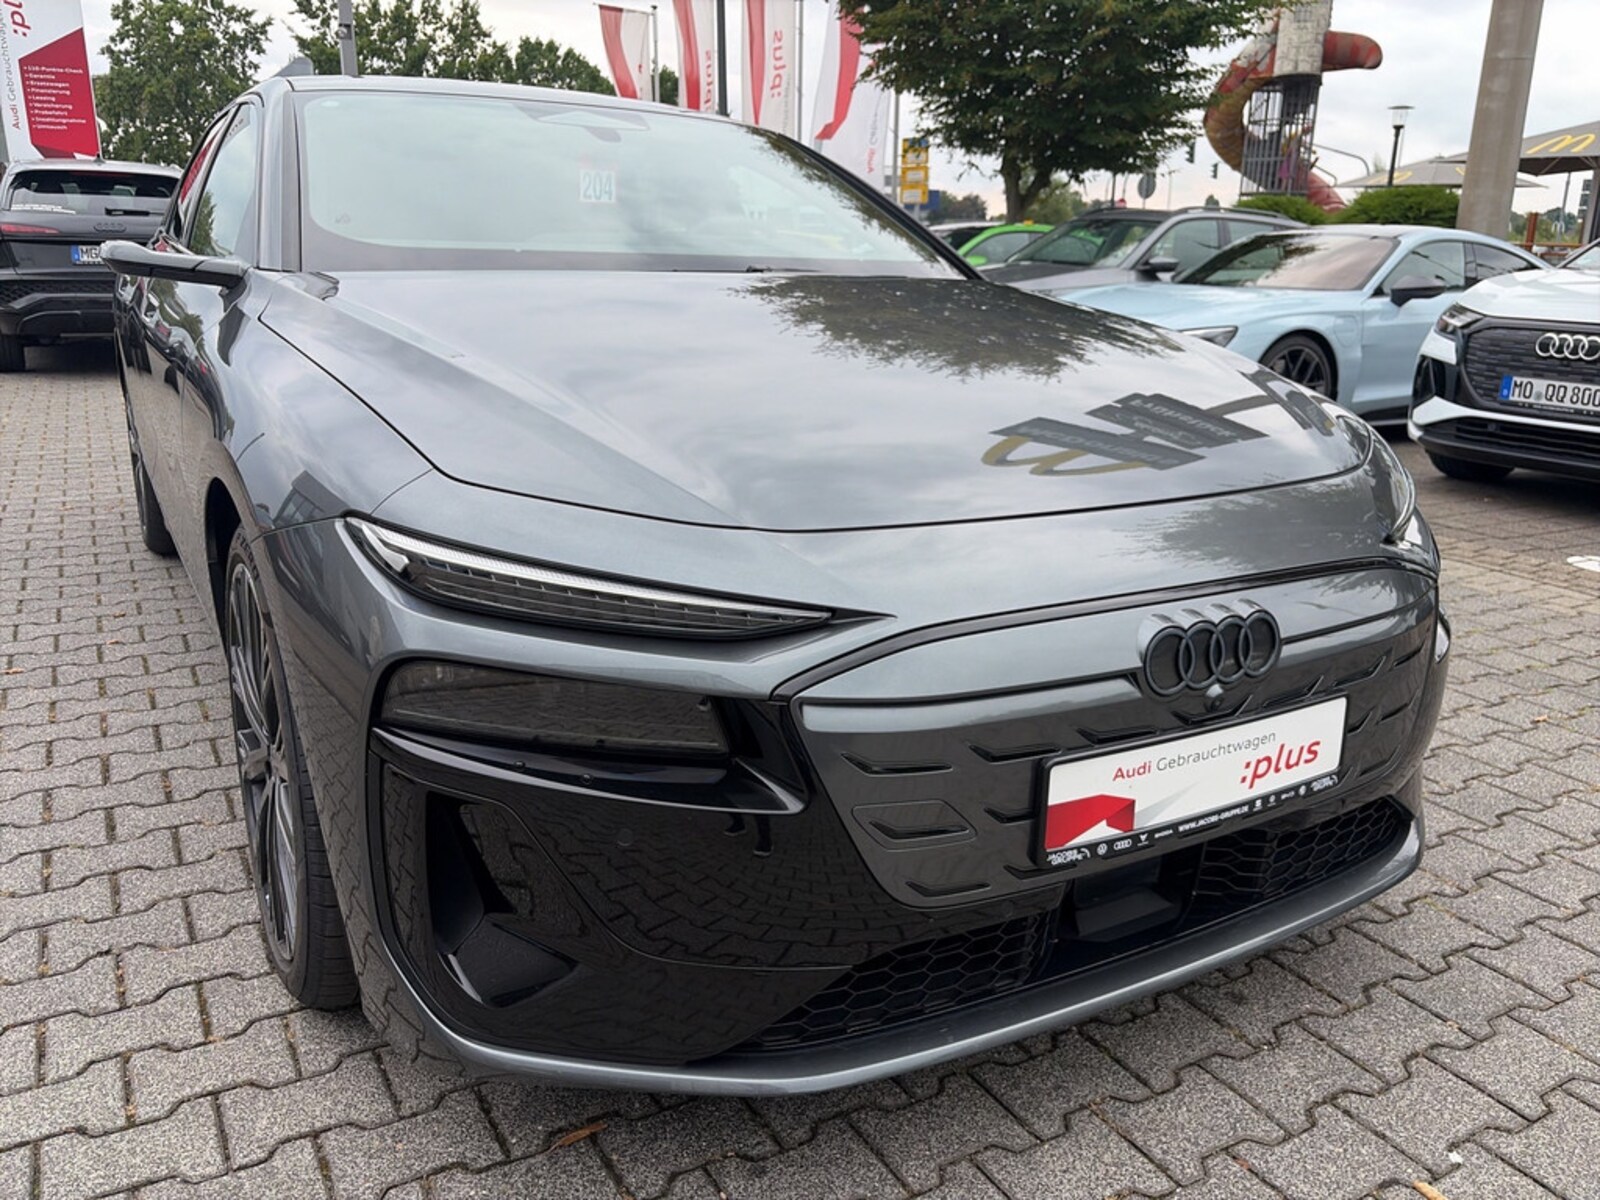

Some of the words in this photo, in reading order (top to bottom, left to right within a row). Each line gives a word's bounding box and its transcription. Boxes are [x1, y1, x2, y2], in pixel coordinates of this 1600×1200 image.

[9, 102, 21, 130] Audi
[582, 171, 613, 201] 204
[1510, 380, 1534, 400] MO
[1544, 383, 1568, 404] QQ
[1569, 386, 1600, 407] 800
[1112, 761, 1152, 782] Audi
[1156, 732, 1276, 772] Gebrauchtwagen
[1240, 739, 1321, 789] :plus
